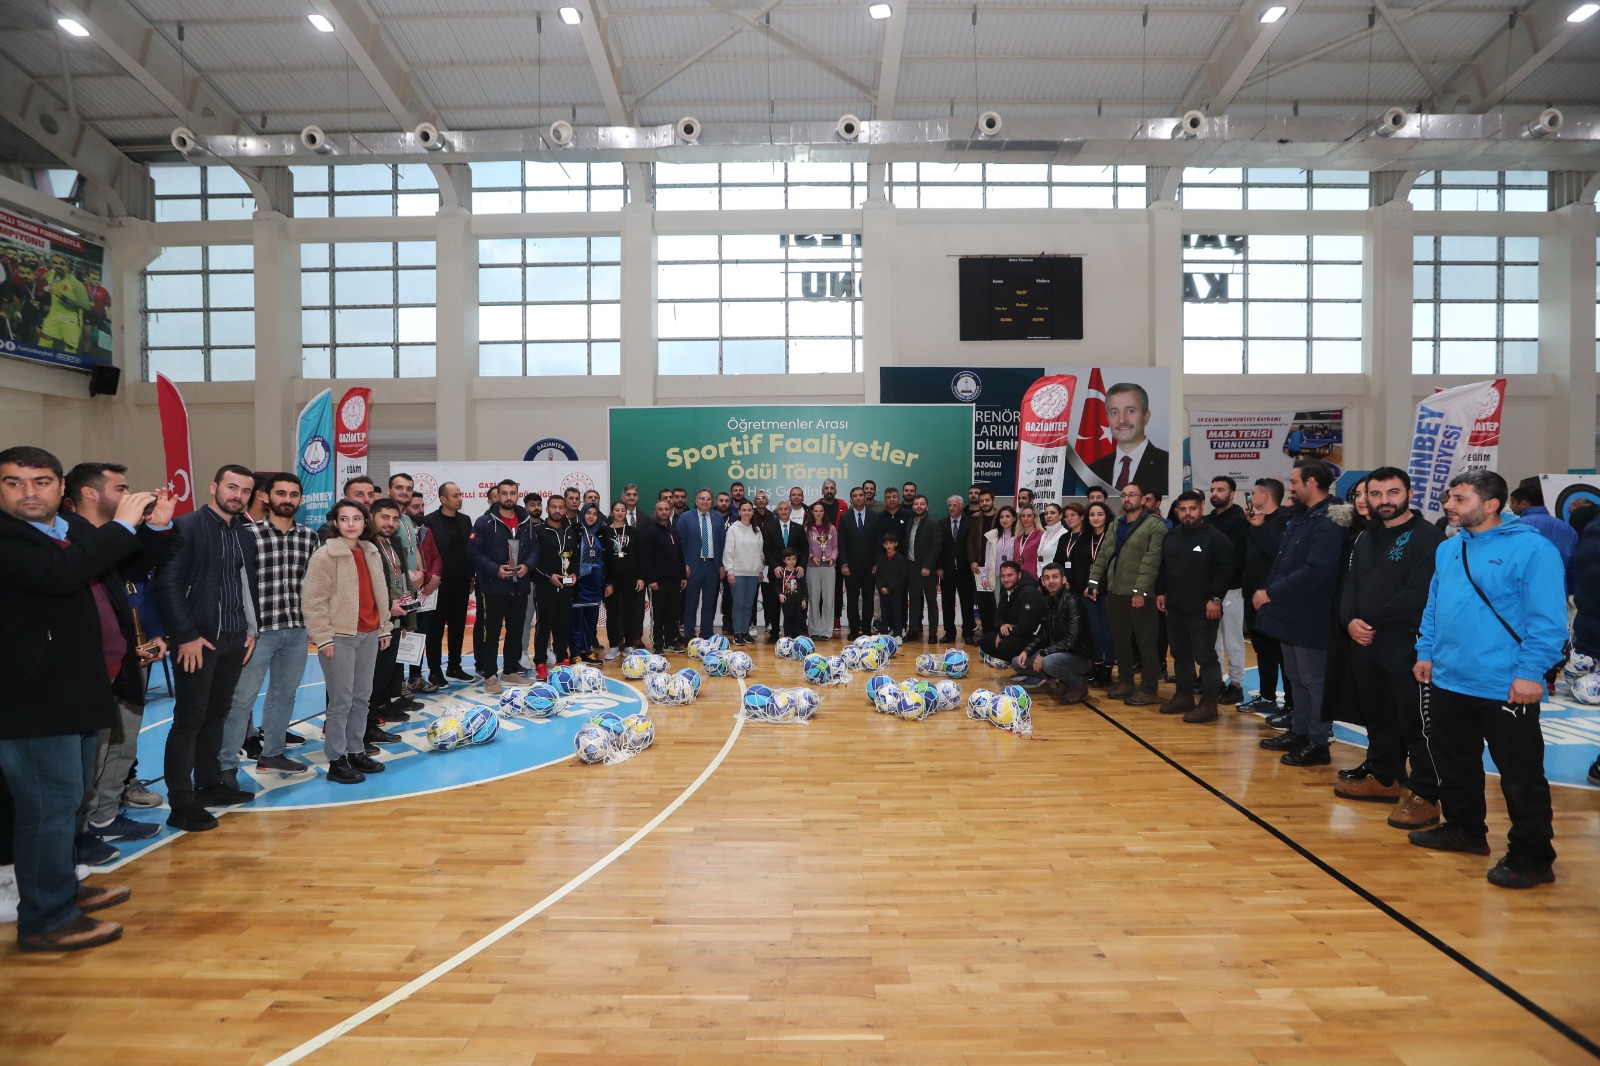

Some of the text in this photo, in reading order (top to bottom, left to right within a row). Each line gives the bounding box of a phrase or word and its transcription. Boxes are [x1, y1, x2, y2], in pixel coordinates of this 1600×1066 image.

[975, 408, 1021, 422] RENÖR
[727, 417, 848, 432] Öğretmenler Arası
[1025, 420, 1068, 432] GAZİANTEP
[1208, 429, 1271, 439] MASA TENİSİ
[536, 441, 565, 451] GAZİANTEP
[666, 433, 919, 469] Sportif Faaliyetler
[1212, 440, 1267, 449] TURNUVASI
[1409, 405, 1445, 509] AHİNBEY
[728, 460, 849, 480] Ödül Töreni
[1427, 424, 1463, 512] BELEDİYESİ
